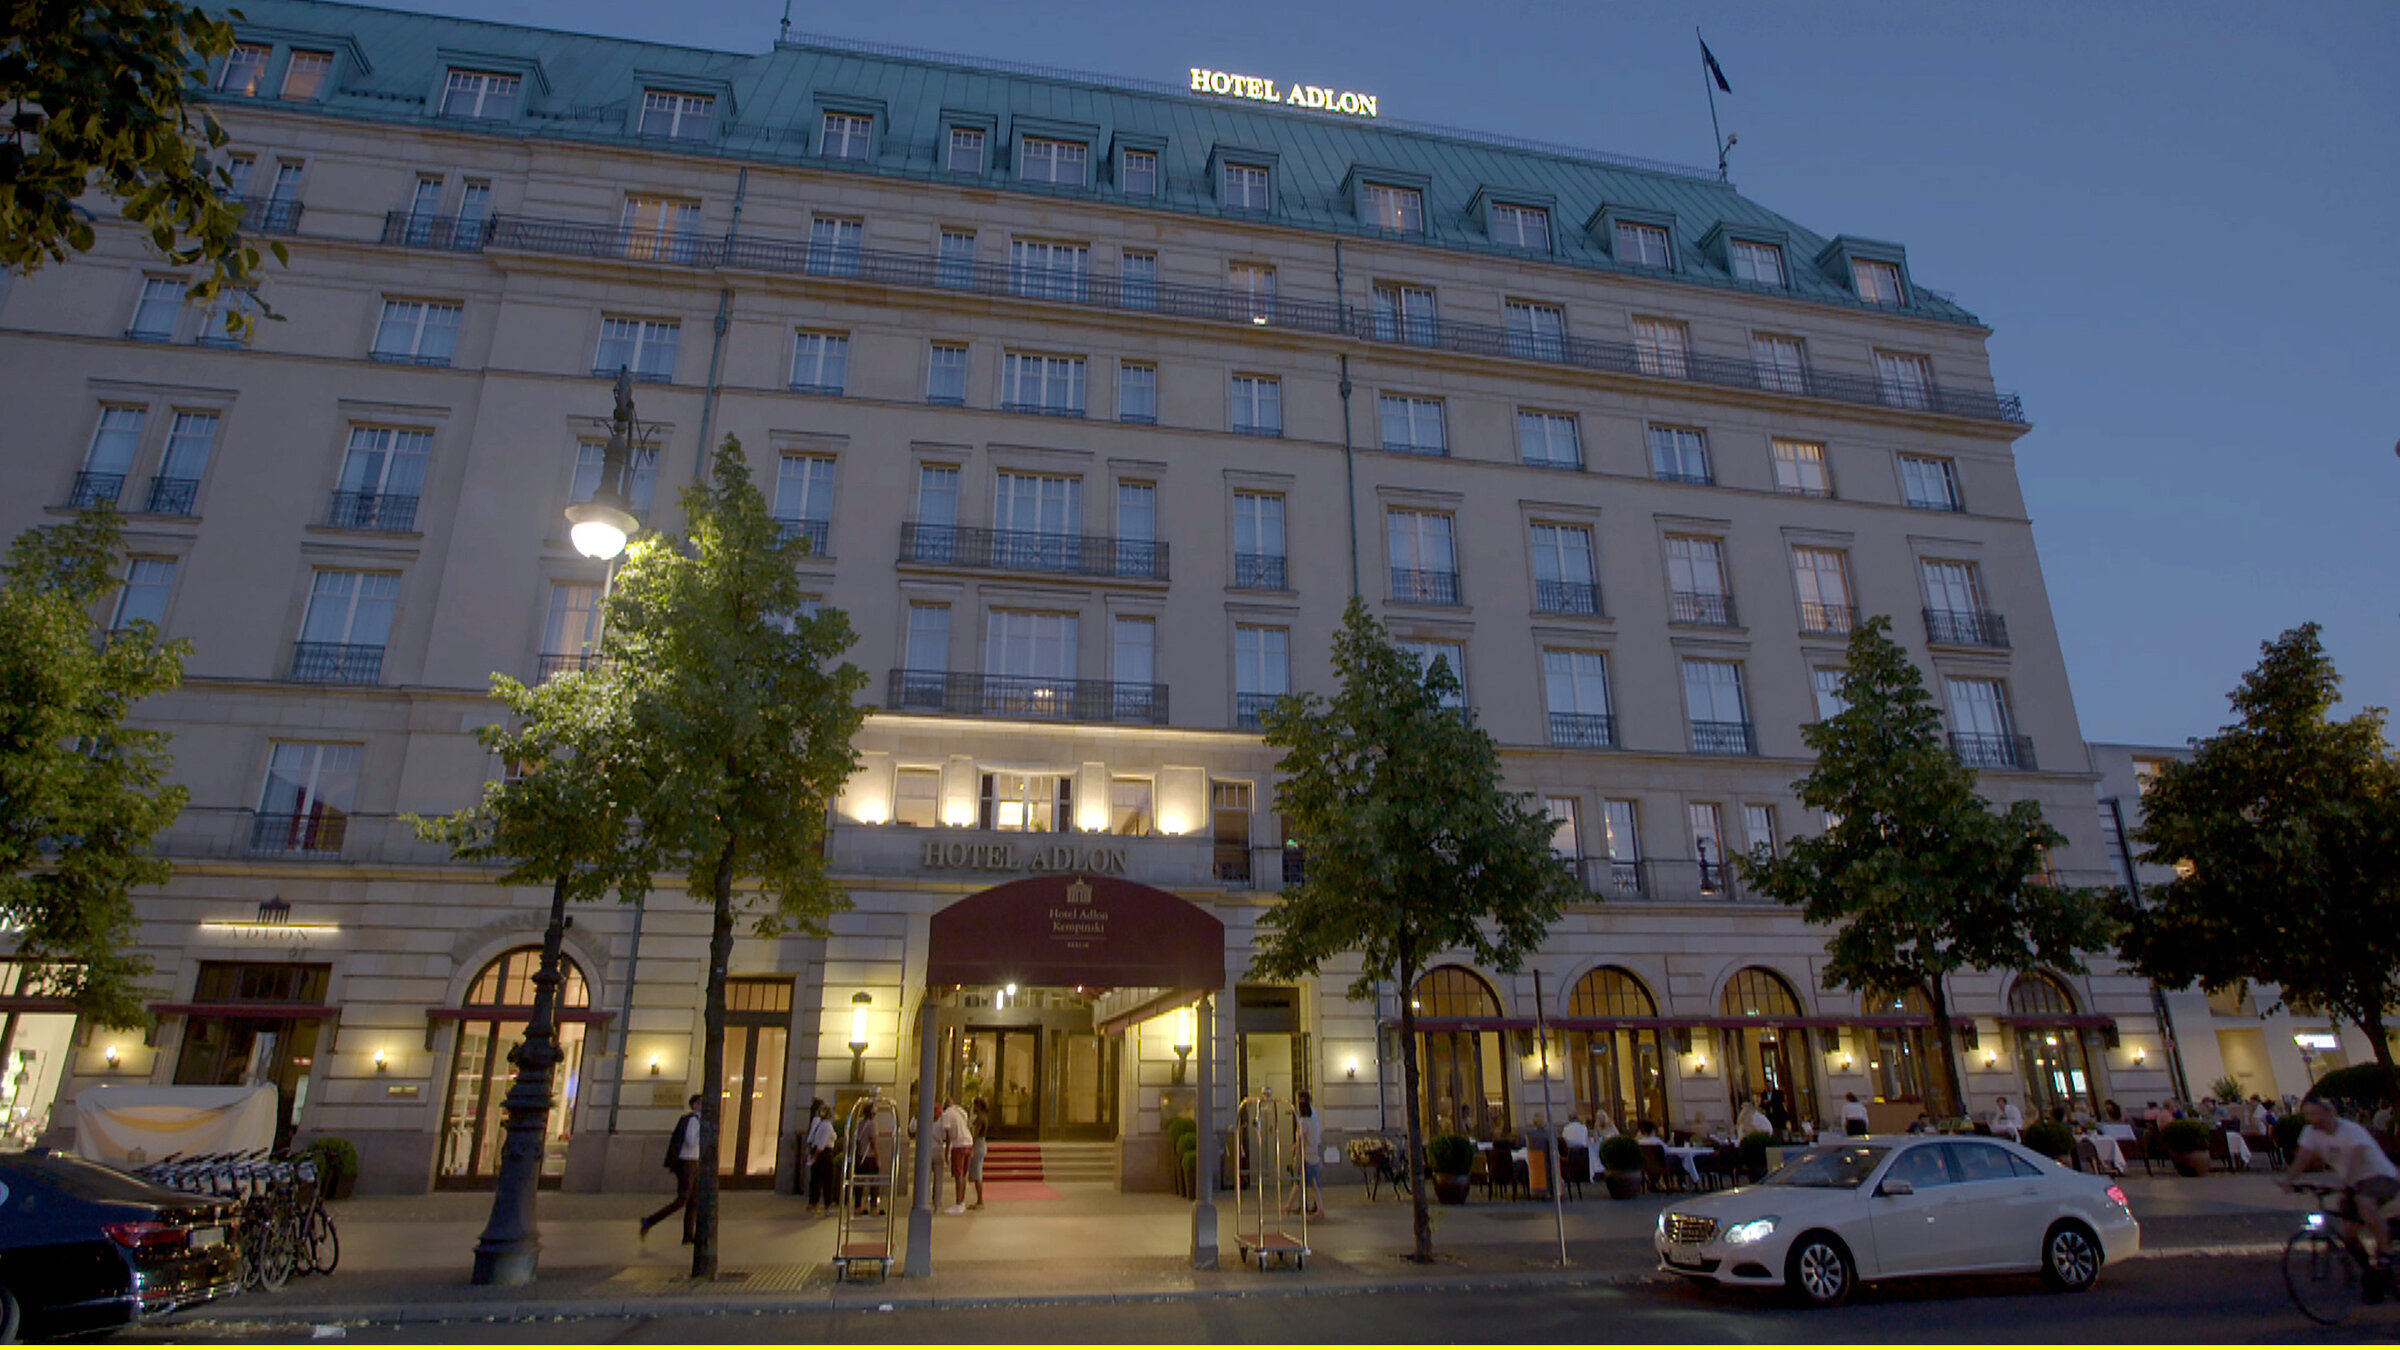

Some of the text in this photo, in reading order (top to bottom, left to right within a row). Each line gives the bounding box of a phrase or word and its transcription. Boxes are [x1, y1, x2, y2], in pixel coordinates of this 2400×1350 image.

[1190, 68, 1377, 117] HOTEL ADLON
[924, 841, 1129, 874] HOTEL ADLON
[1049, 907, 1109, 921] Hotel Adlon
[1052, 920, 1105, 935] Kempinski
